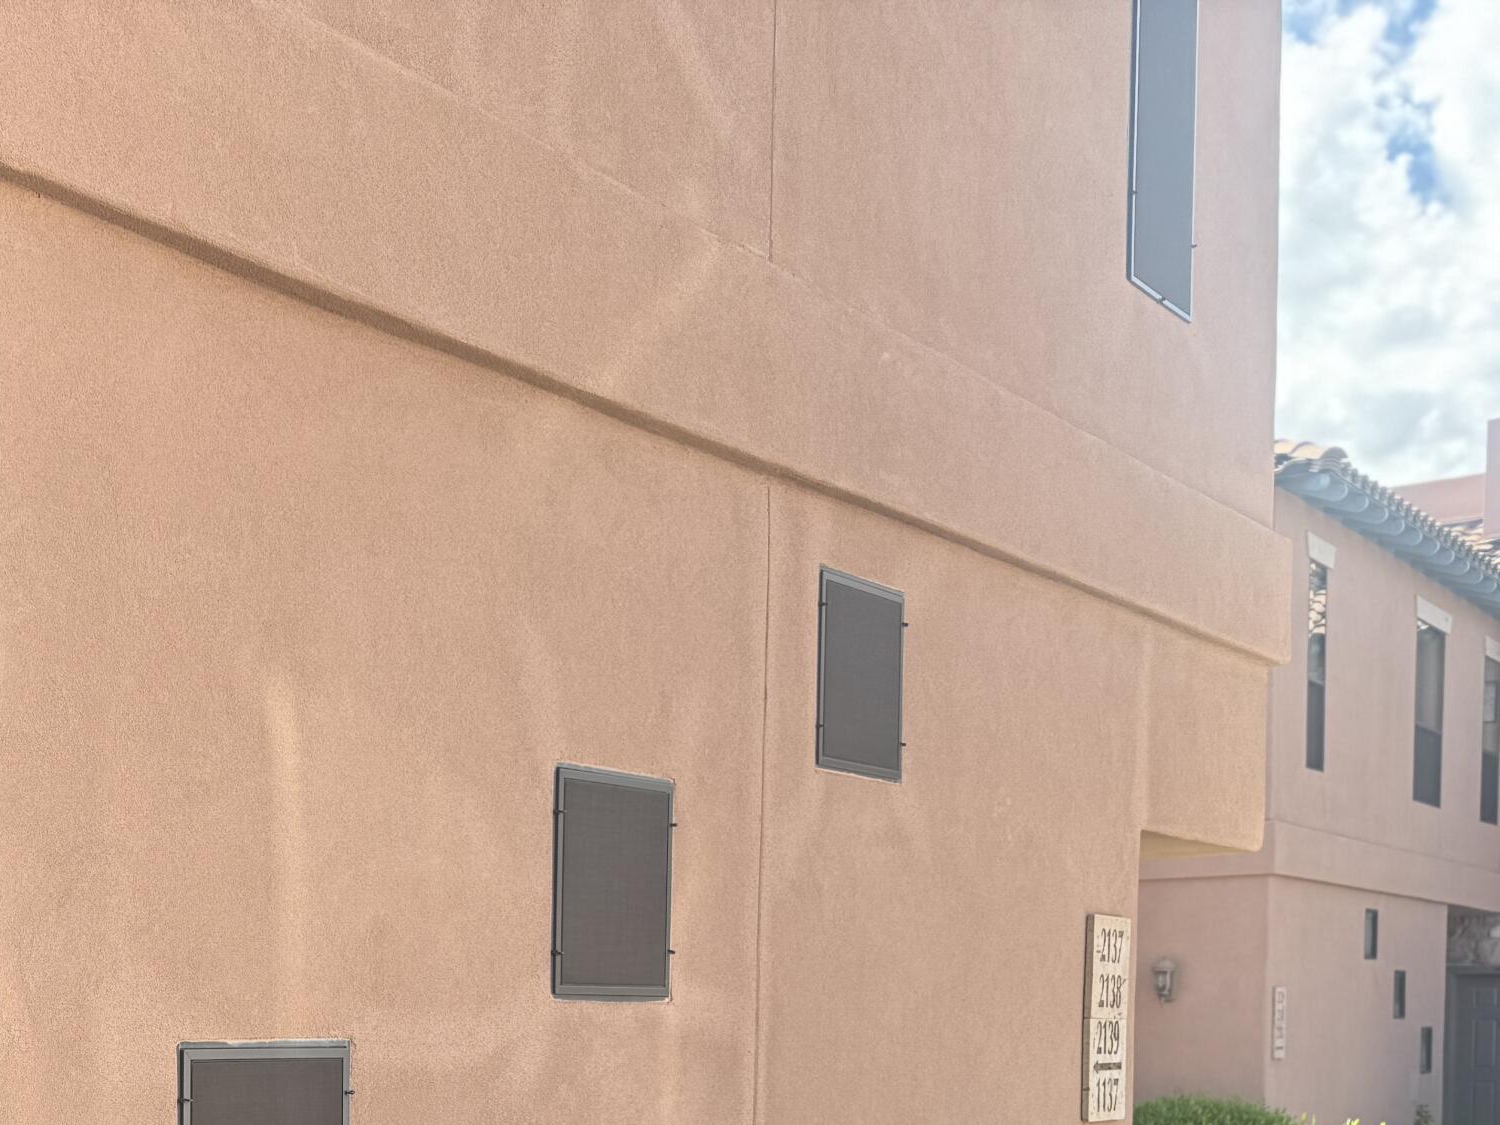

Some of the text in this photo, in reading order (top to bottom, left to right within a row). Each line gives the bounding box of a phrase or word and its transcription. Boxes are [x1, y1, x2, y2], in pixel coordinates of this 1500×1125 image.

[1099, 928, 1125, 964] 2137
[1098, 973, 1123, 1009] 2138
[1096, 1020, 1120, 1055] 2139
[1096, 1077, 1120, 1113] 1137
